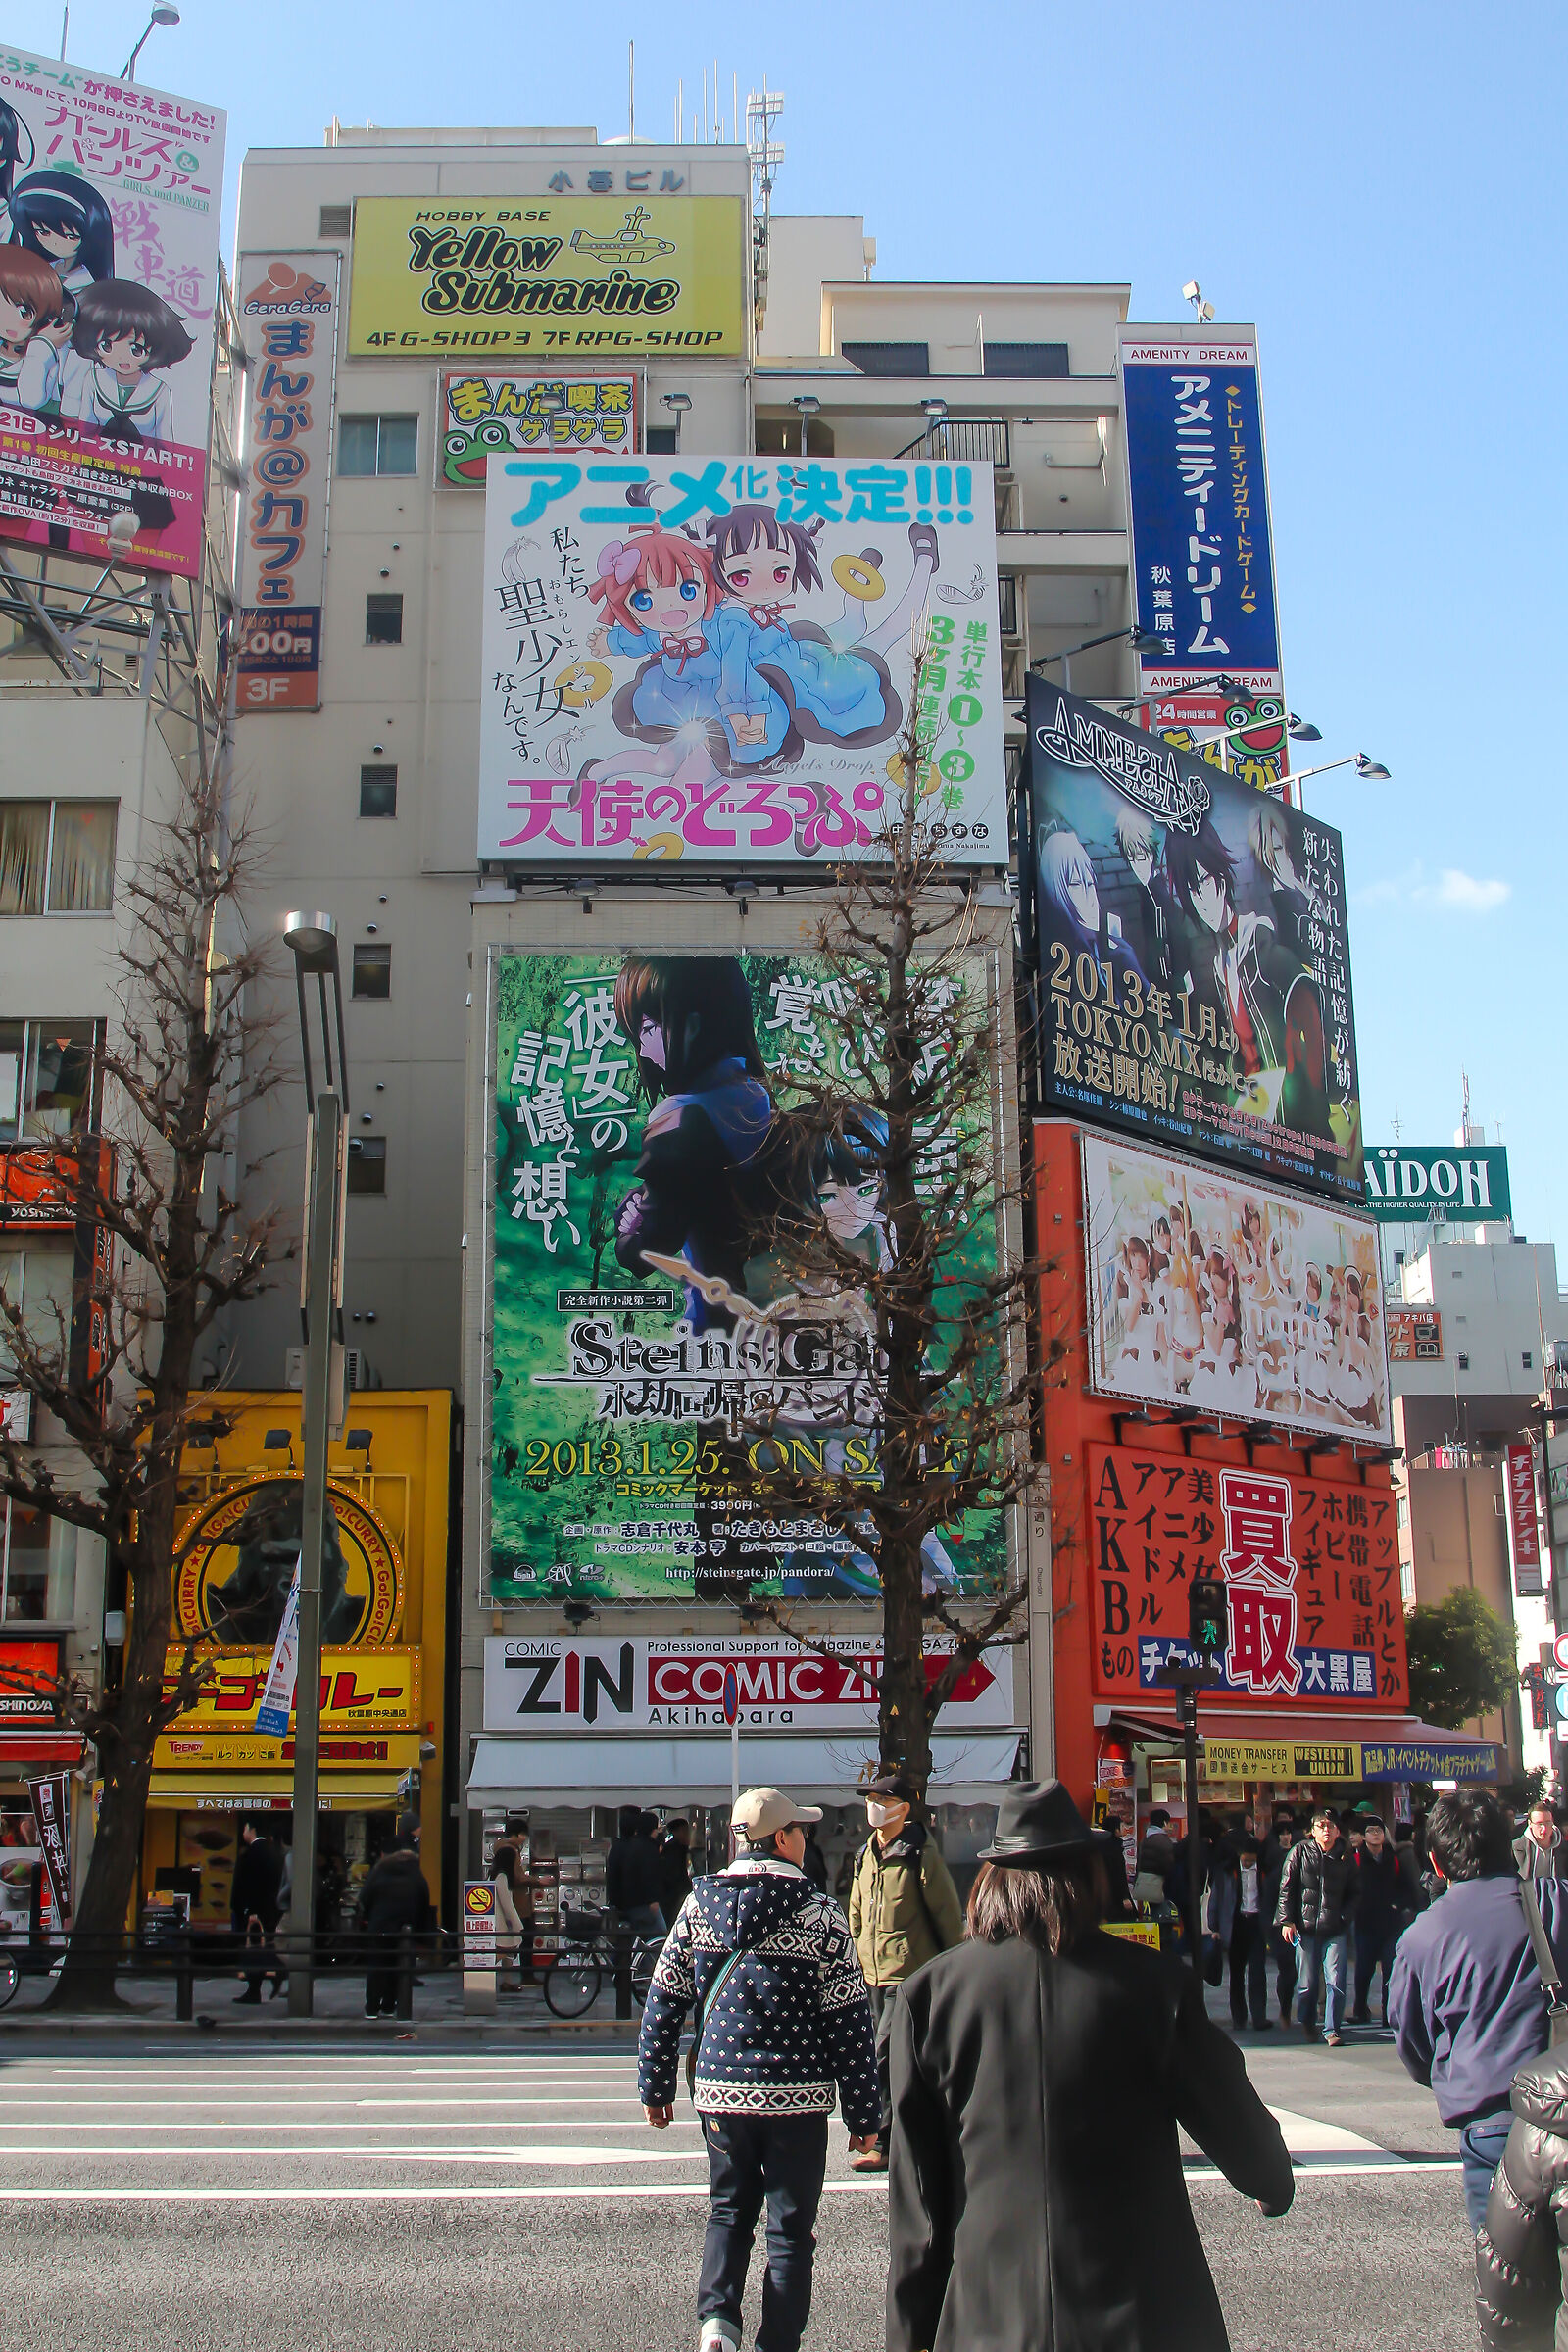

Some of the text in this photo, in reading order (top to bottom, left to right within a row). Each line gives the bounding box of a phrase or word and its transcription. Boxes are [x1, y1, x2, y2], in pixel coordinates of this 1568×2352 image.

[416, 210, 552, 221] HOBBY BASE
[408, 226, 565, 272] Yellow
[422, 270, 681, 315] Submarine
[367, 332, 397, 346] 4F
[542, 331, 571, 346] 7F
[574, 330, 724, 346] RPG-SHOP
[1130, 349, 1249, 361] AMENITY DREAM
[246, 676, 291, 703] 3F
[748, 1438, 827, 1475] ON
[1159, 1464, 1189, 1585] アニメ
[1220, 1469, 1303, 1696] 買取
[504, 1642, 562, 1656] COMIC
[647, 1641, 725, 1652] Professional
[728, 1641, 780, 1654] Support
[784, 1641, 802, 1651] for
[1304, 1651, 1374, 1693] 大黒屋
[504, 1642, 635, 1725] ZIN
[1209, 1747, 1288, 1761] MONEY TRANSFER
[1295, 1747, 1346, 1761] WESTERN
[1309, 1761, 1346, 1775] UNION
